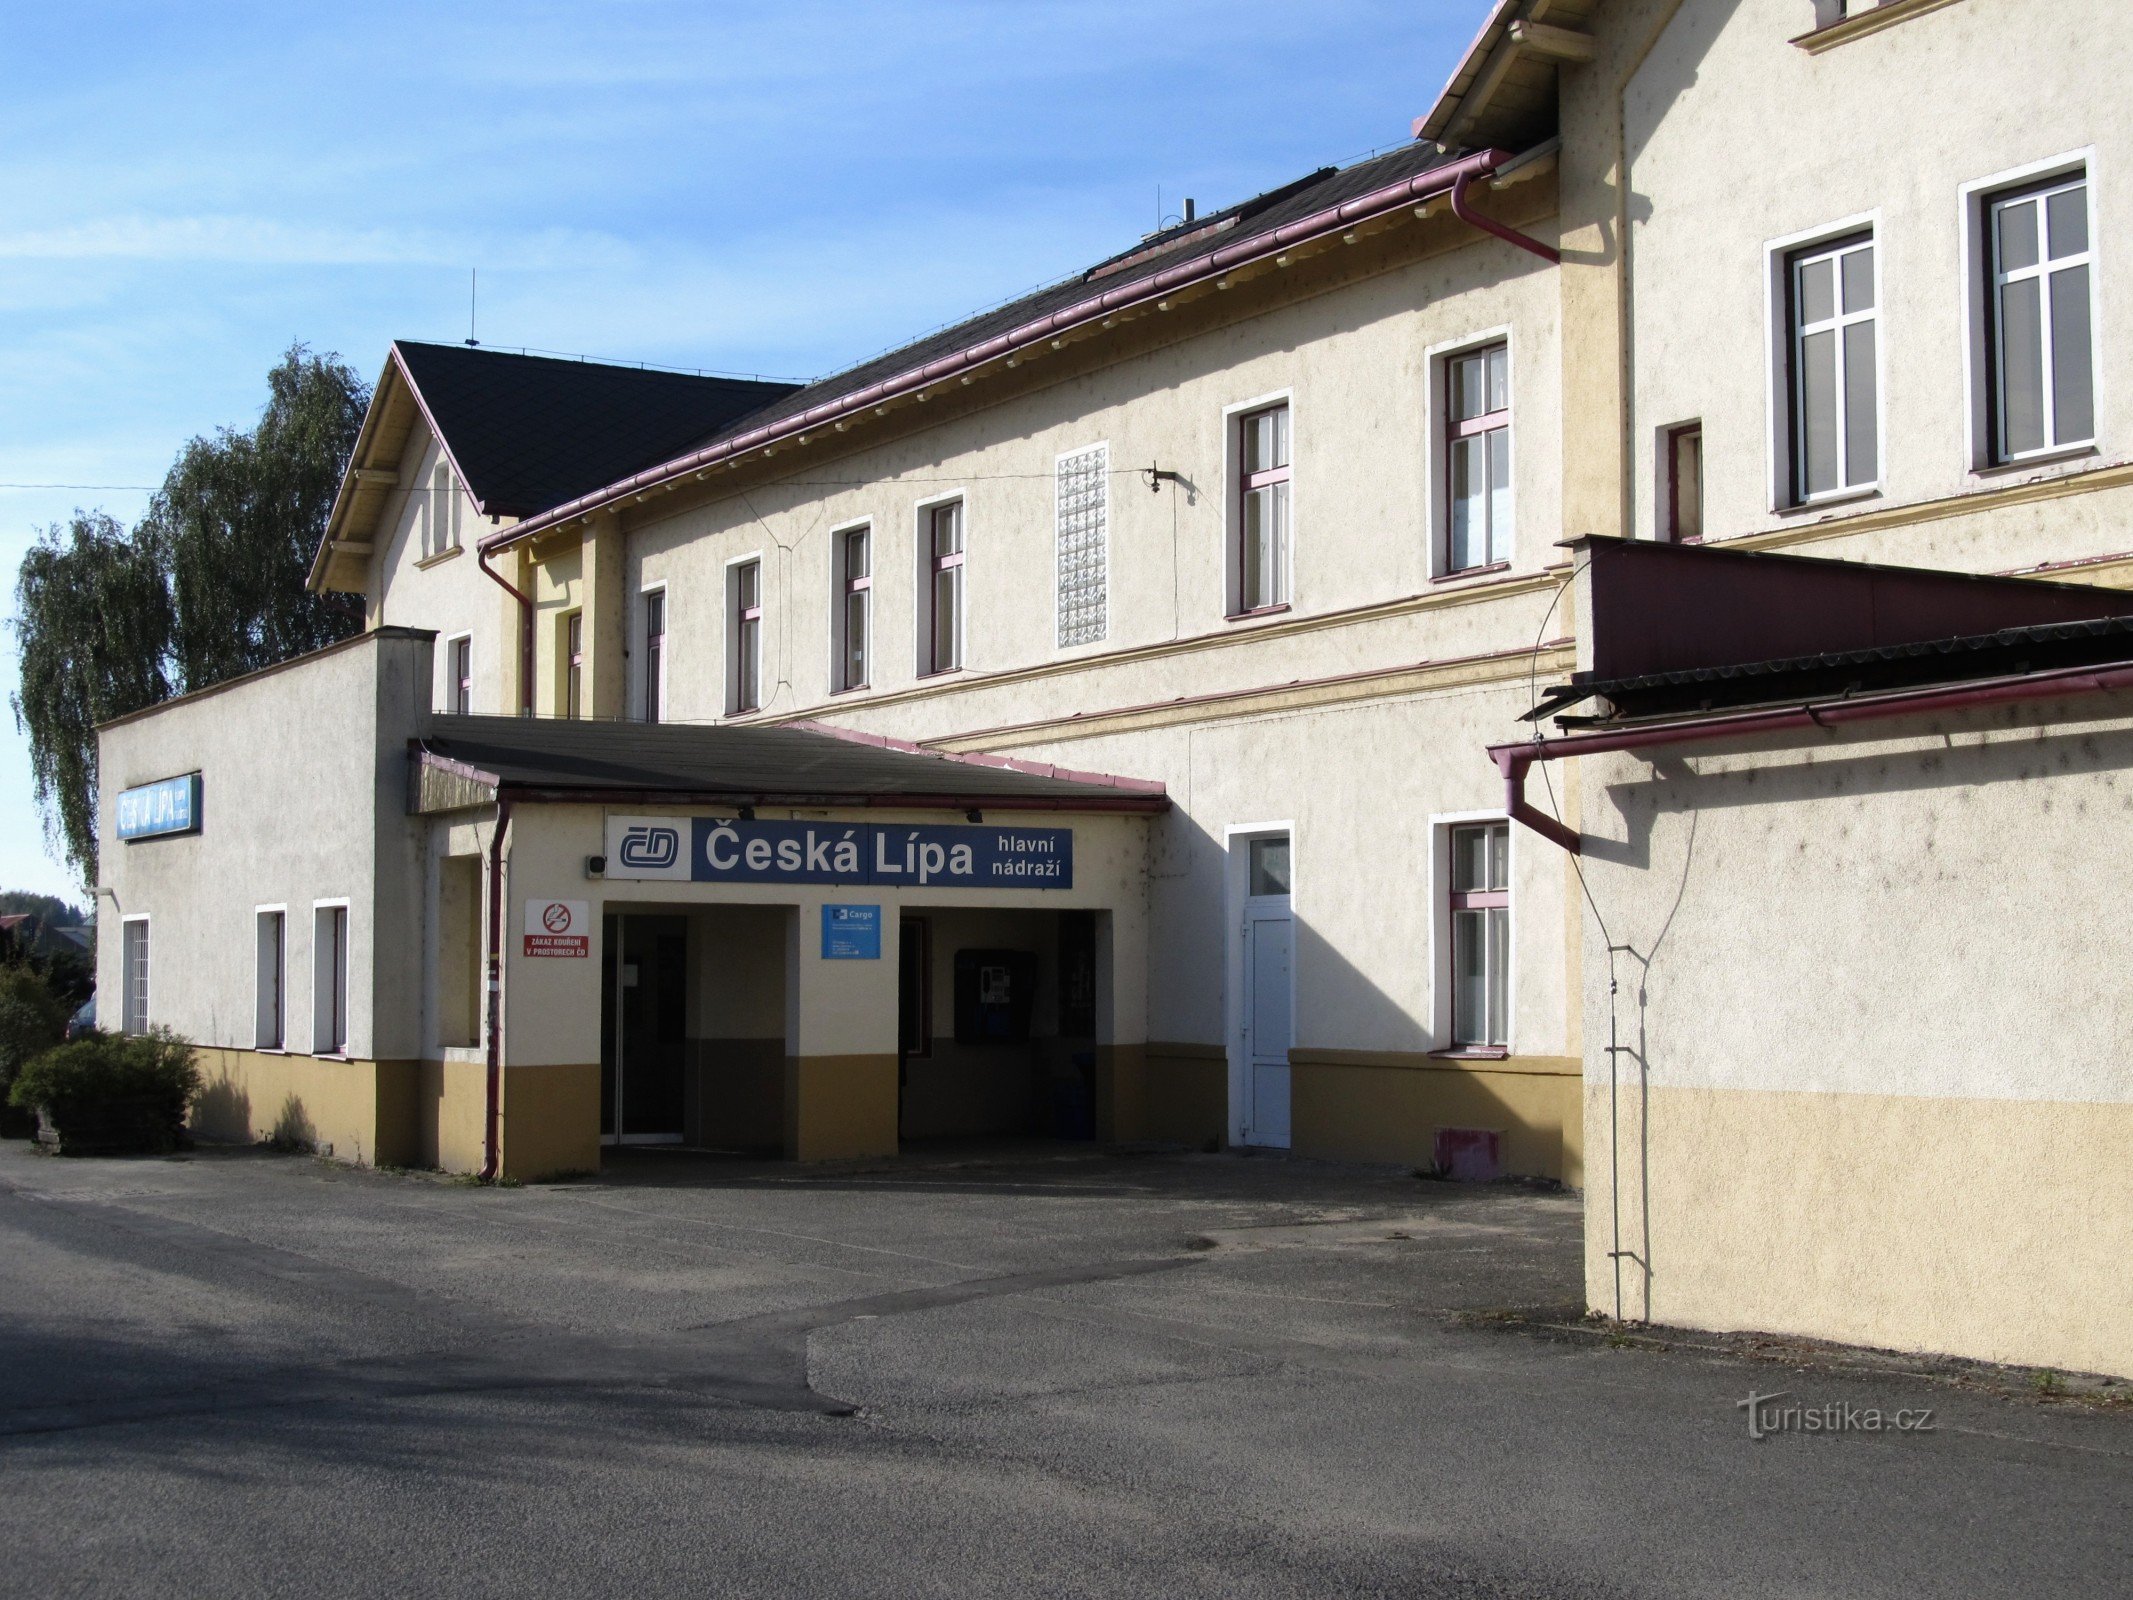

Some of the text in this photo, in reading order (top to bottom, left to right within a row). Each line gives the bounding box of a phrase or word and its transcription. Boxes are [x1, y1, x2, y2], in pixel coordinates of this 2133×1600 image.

[706, 818, 974, 884] Česká Lípa
[998, 835, 1056, 853] hlavní
[992, 858, 1061, 877] nádraží
[849, 910, 873, 921] Cargo
[531, 936, 581, 946] ZÁKAZ KOUŘENÍ
[526, 946, 586, 957] V PROSTORECH ČD
